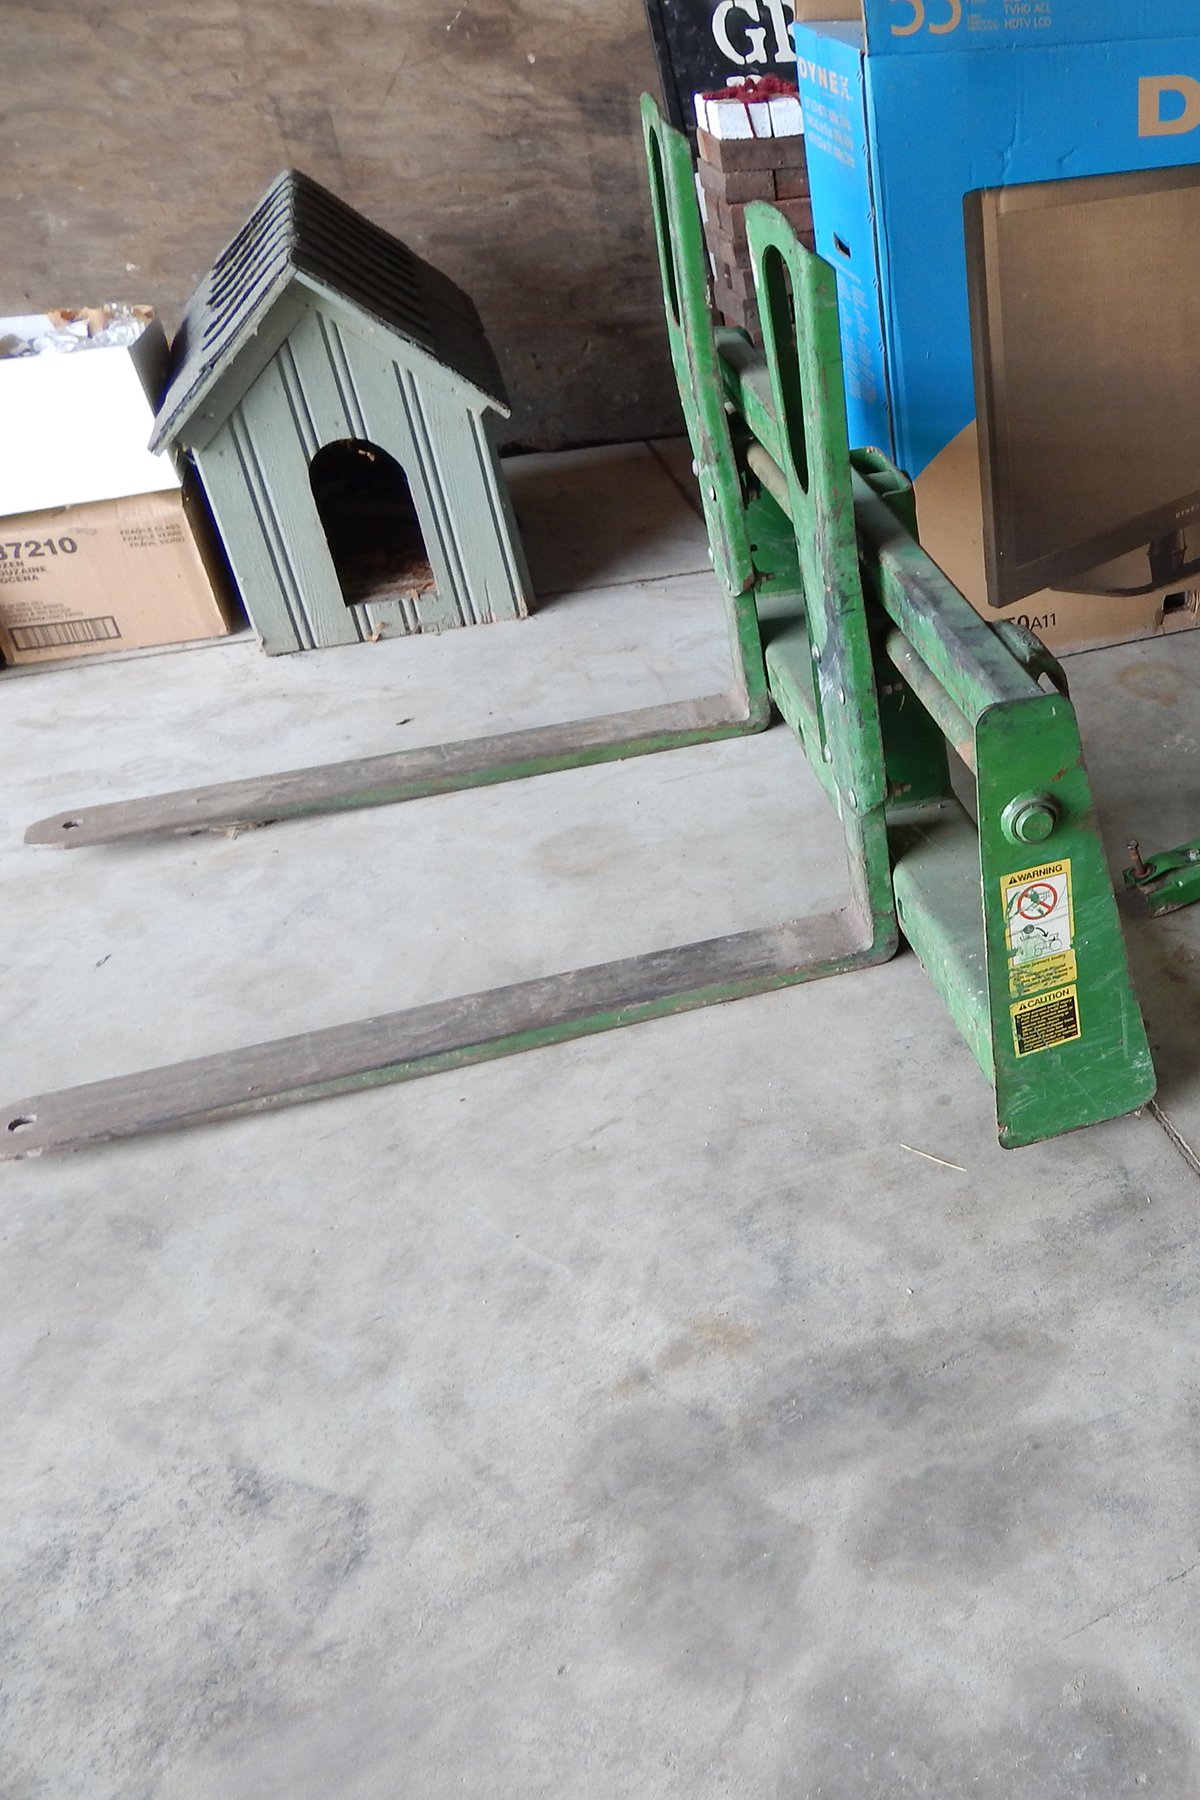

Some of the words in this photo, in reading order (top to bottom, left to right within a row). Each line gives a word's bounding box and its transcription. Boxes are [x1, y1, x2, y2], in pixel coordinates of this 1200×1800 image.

[1004, 18, 1031, 30] HDTV
[1033, 16, 1052, 28] LCD
[799, 56, 851, 101] DYNEX
[1017, 864, 1063, 882] WARNING
[1027, 989, 1070, 1009] CAUTION
